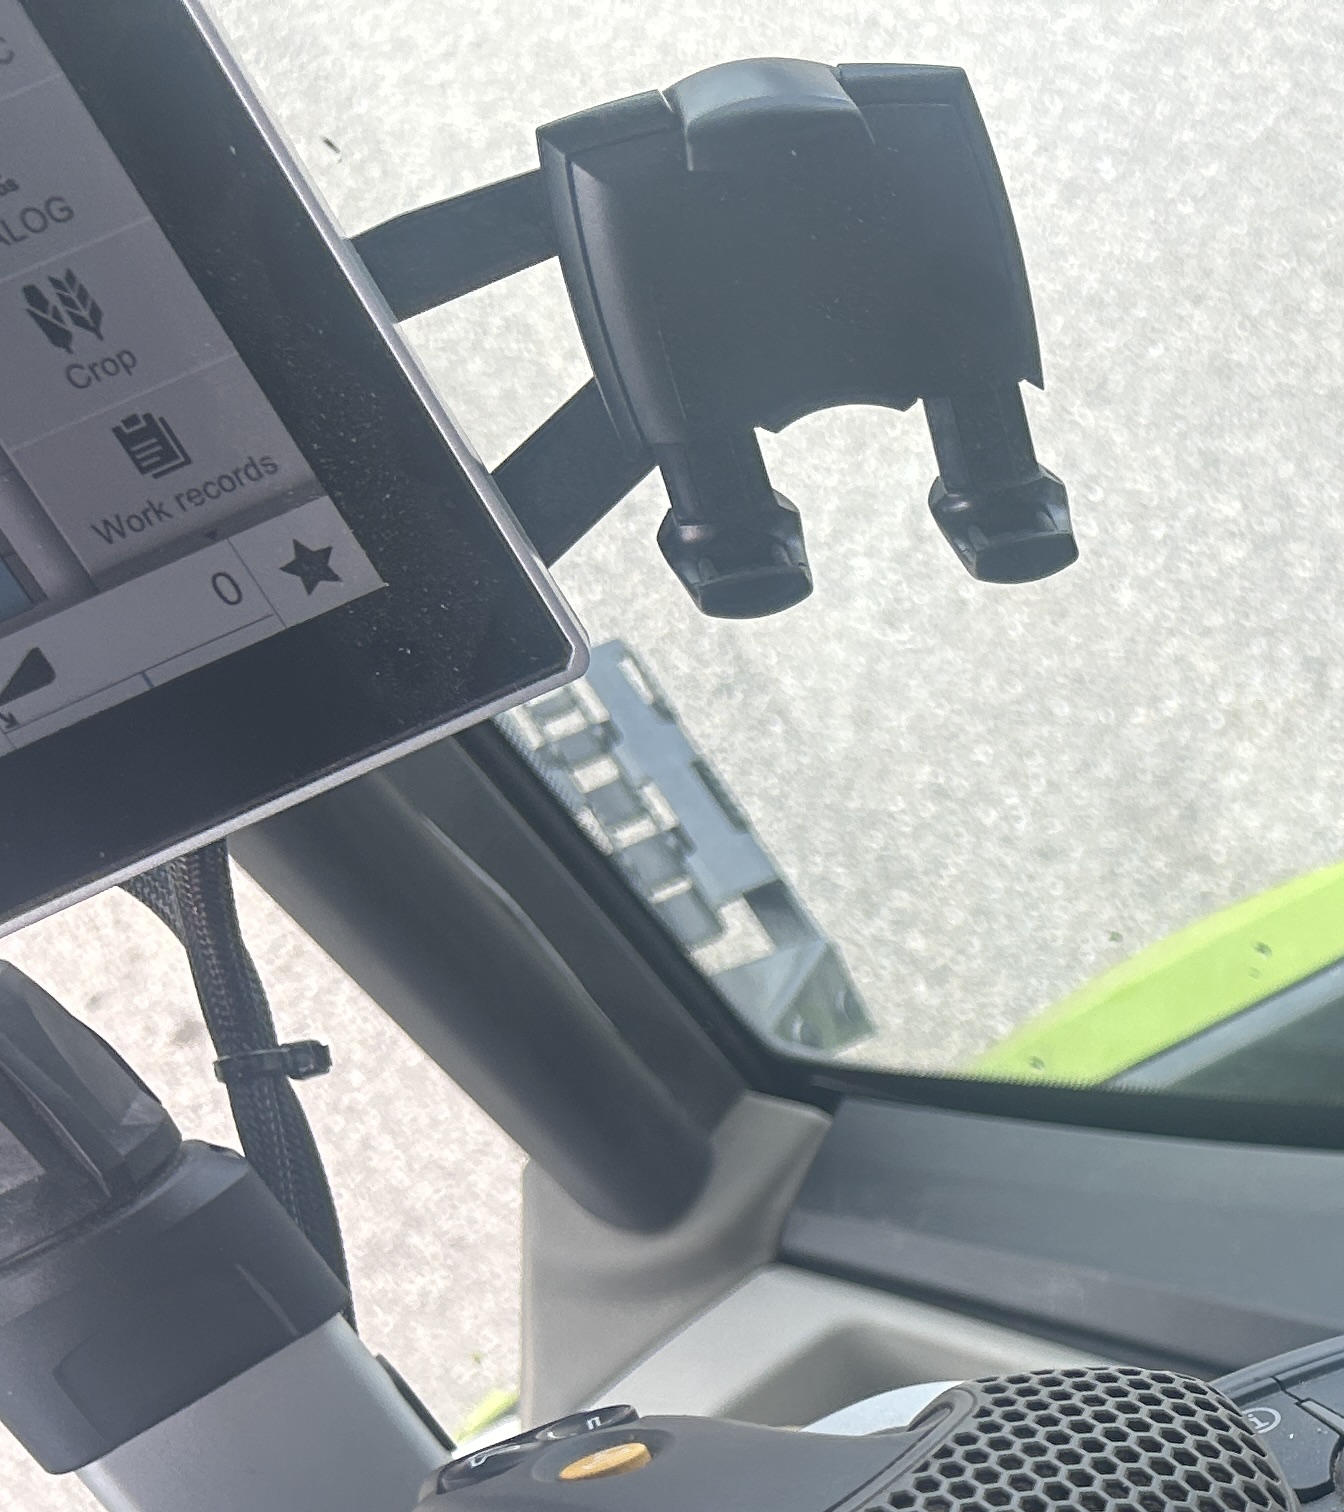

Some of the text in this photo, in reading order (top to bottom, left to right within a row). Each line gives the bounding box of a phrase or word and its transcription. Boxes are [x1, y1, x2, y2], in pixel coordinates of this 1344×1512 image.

[65, 349, 138, 389] Crop
[90, 455, 279, 545] Work records
[211, 571, 243, 606] 0
